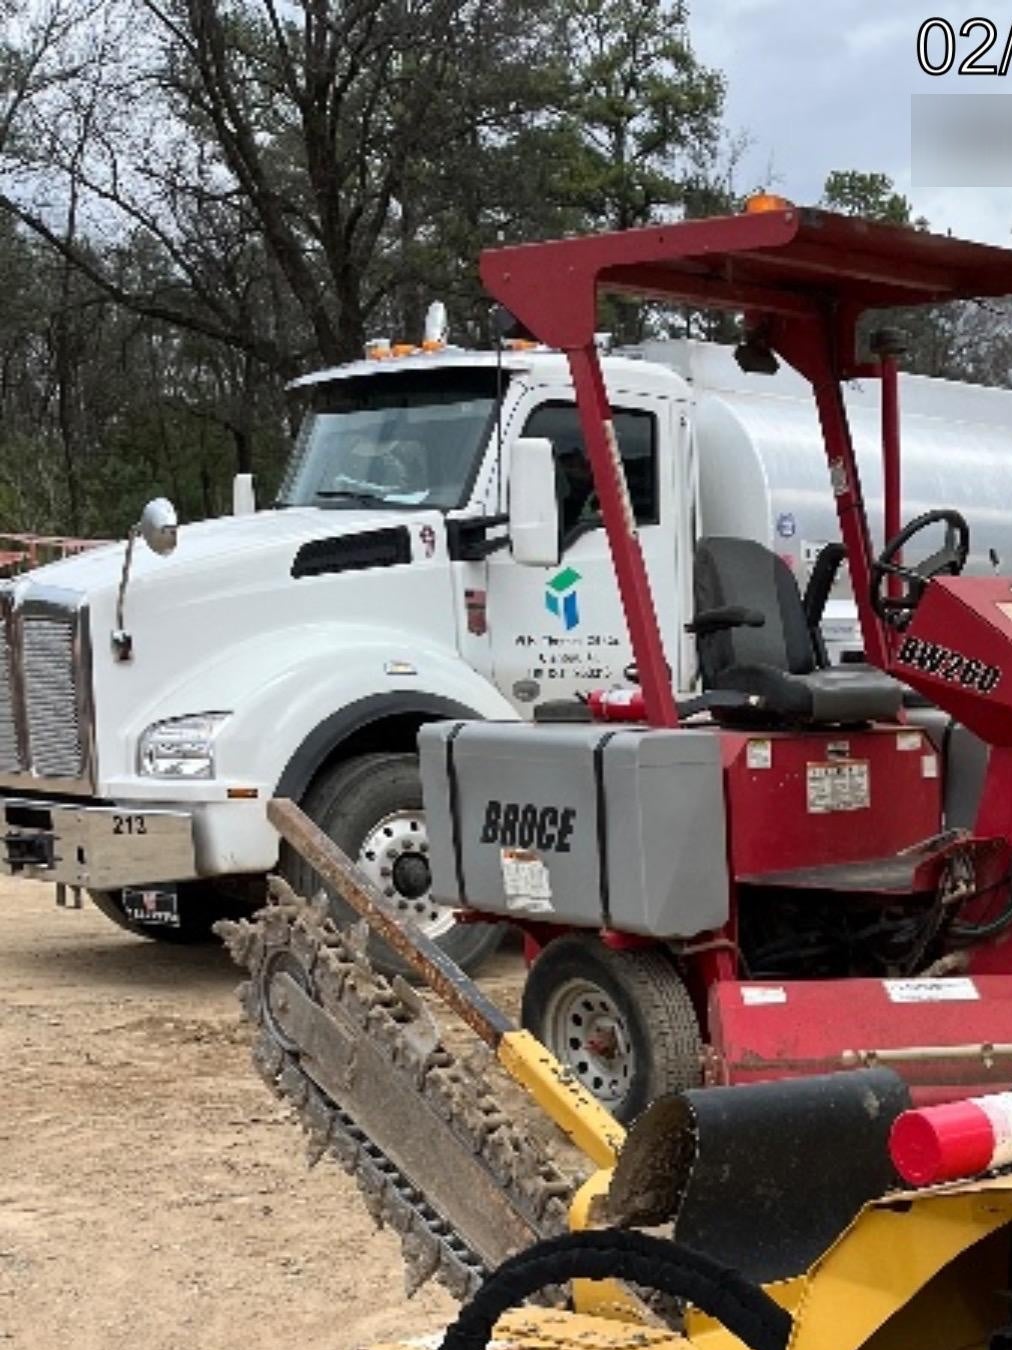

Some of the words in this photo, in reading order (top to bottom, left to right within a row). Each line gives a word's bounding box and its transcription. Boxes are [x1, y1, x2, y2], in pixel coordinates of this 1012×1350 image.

[897, 636, 1002, 693] BW260
[112, 815, 147, 835] 213
[480, 799, 577, 853] BROCE
